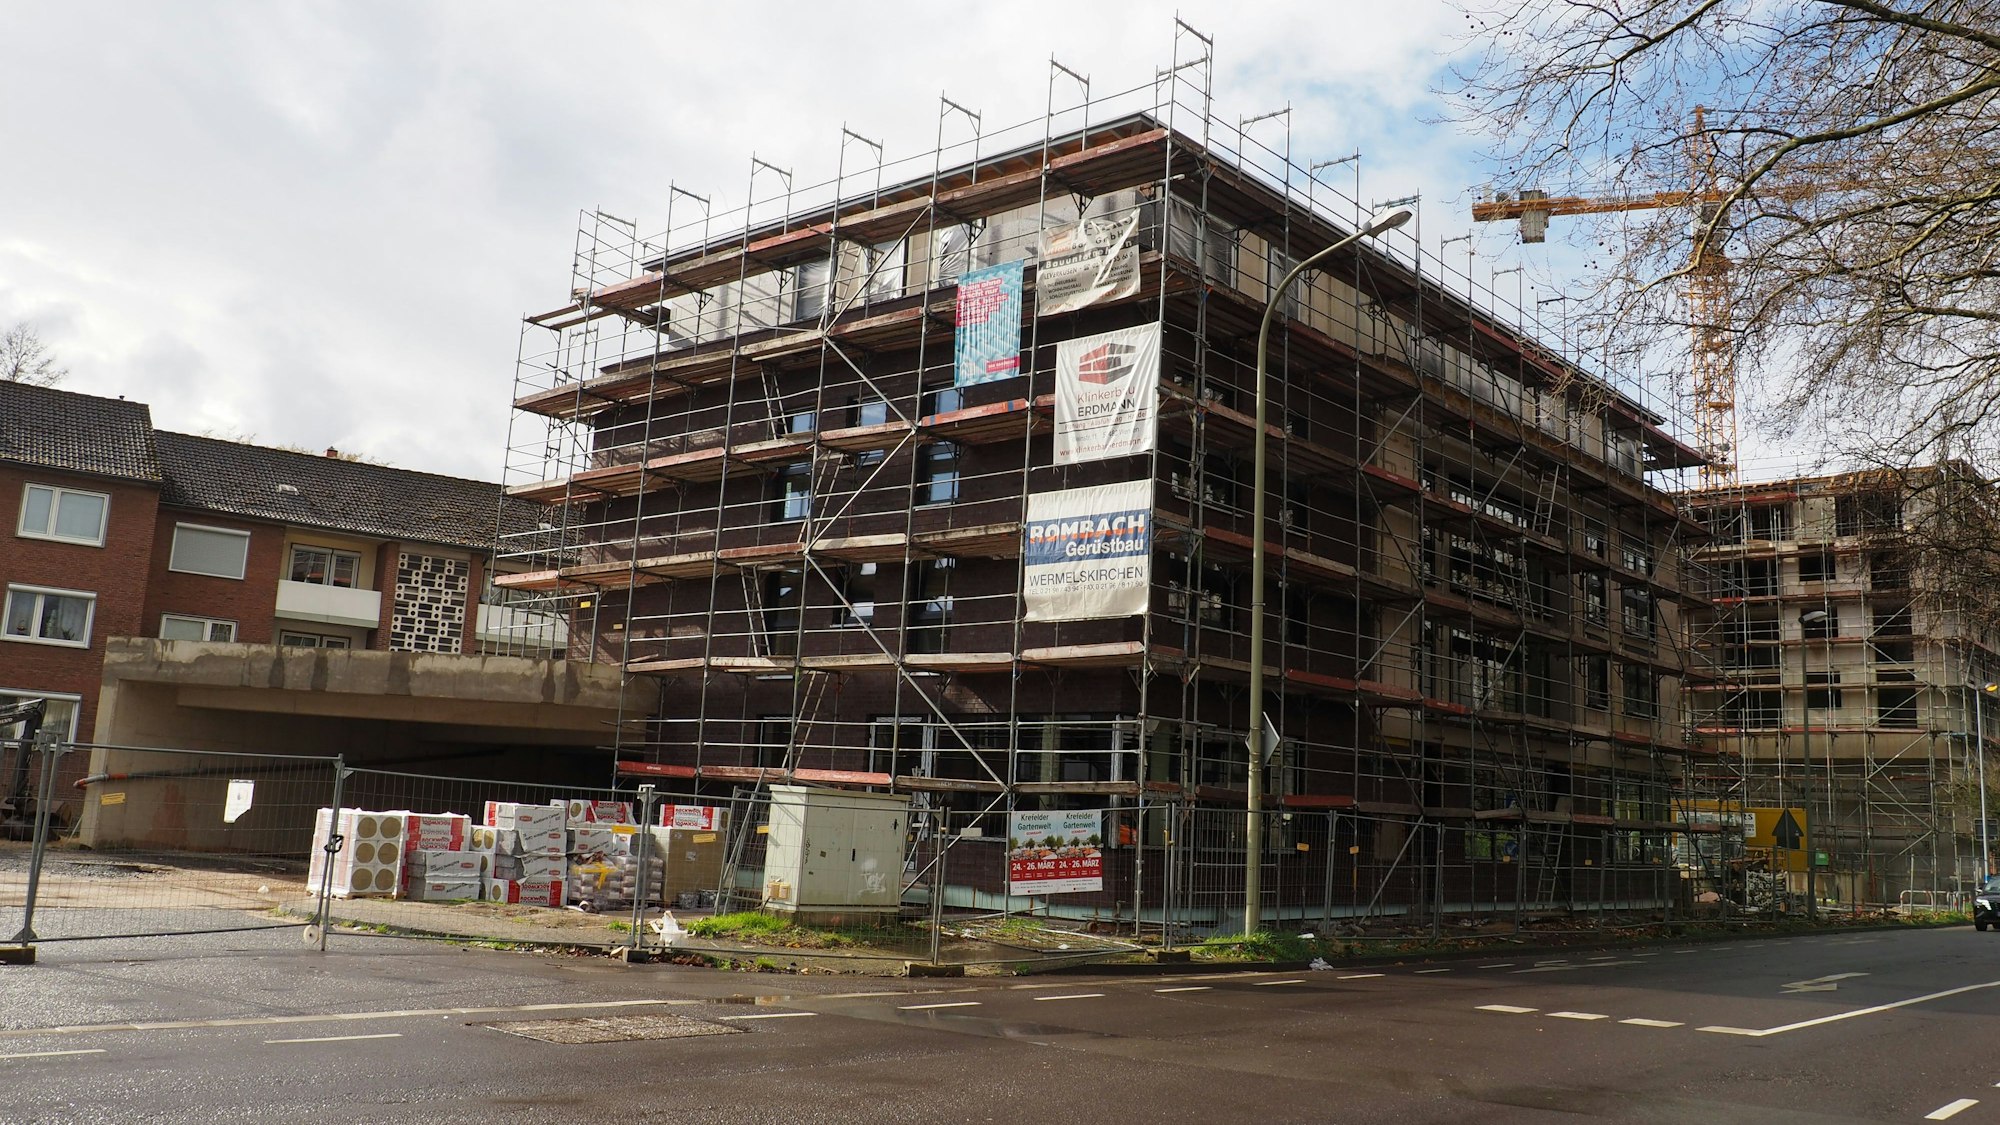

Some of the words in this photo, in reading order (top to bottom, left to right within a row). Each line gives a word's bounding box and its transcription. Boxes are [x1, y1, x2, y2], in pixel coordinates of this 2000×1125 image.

[1077, 386, 1135, 405] Klinkerbu
[1077, 398, 1135, 418] ERDMANN
[1029, 514, 1145, 544] ROMBACH
[1065, 538, 1144, 557] Gerüstbau
[1029, 565, 1143, 587] WERMELSKIRCHEN
[1020, 813, 1050, 821] Krefelder
[1065, 812, 1093, 820] Krefelder
[1017, 821, 1052, 831] Gartenwelt
[1063, 821, 1096, 829] Gartenwelt
[1012, 863, 1022, 871] 24.
[1026, 862, 1037, 870] 26.
[1037, 860, 1055, 870] MÄRZ
[1059, 861, 1068, 869] 24.
[1072, 860, 1081, 868] 26.
[1082, 858, 1100, 868] MÄRZ
